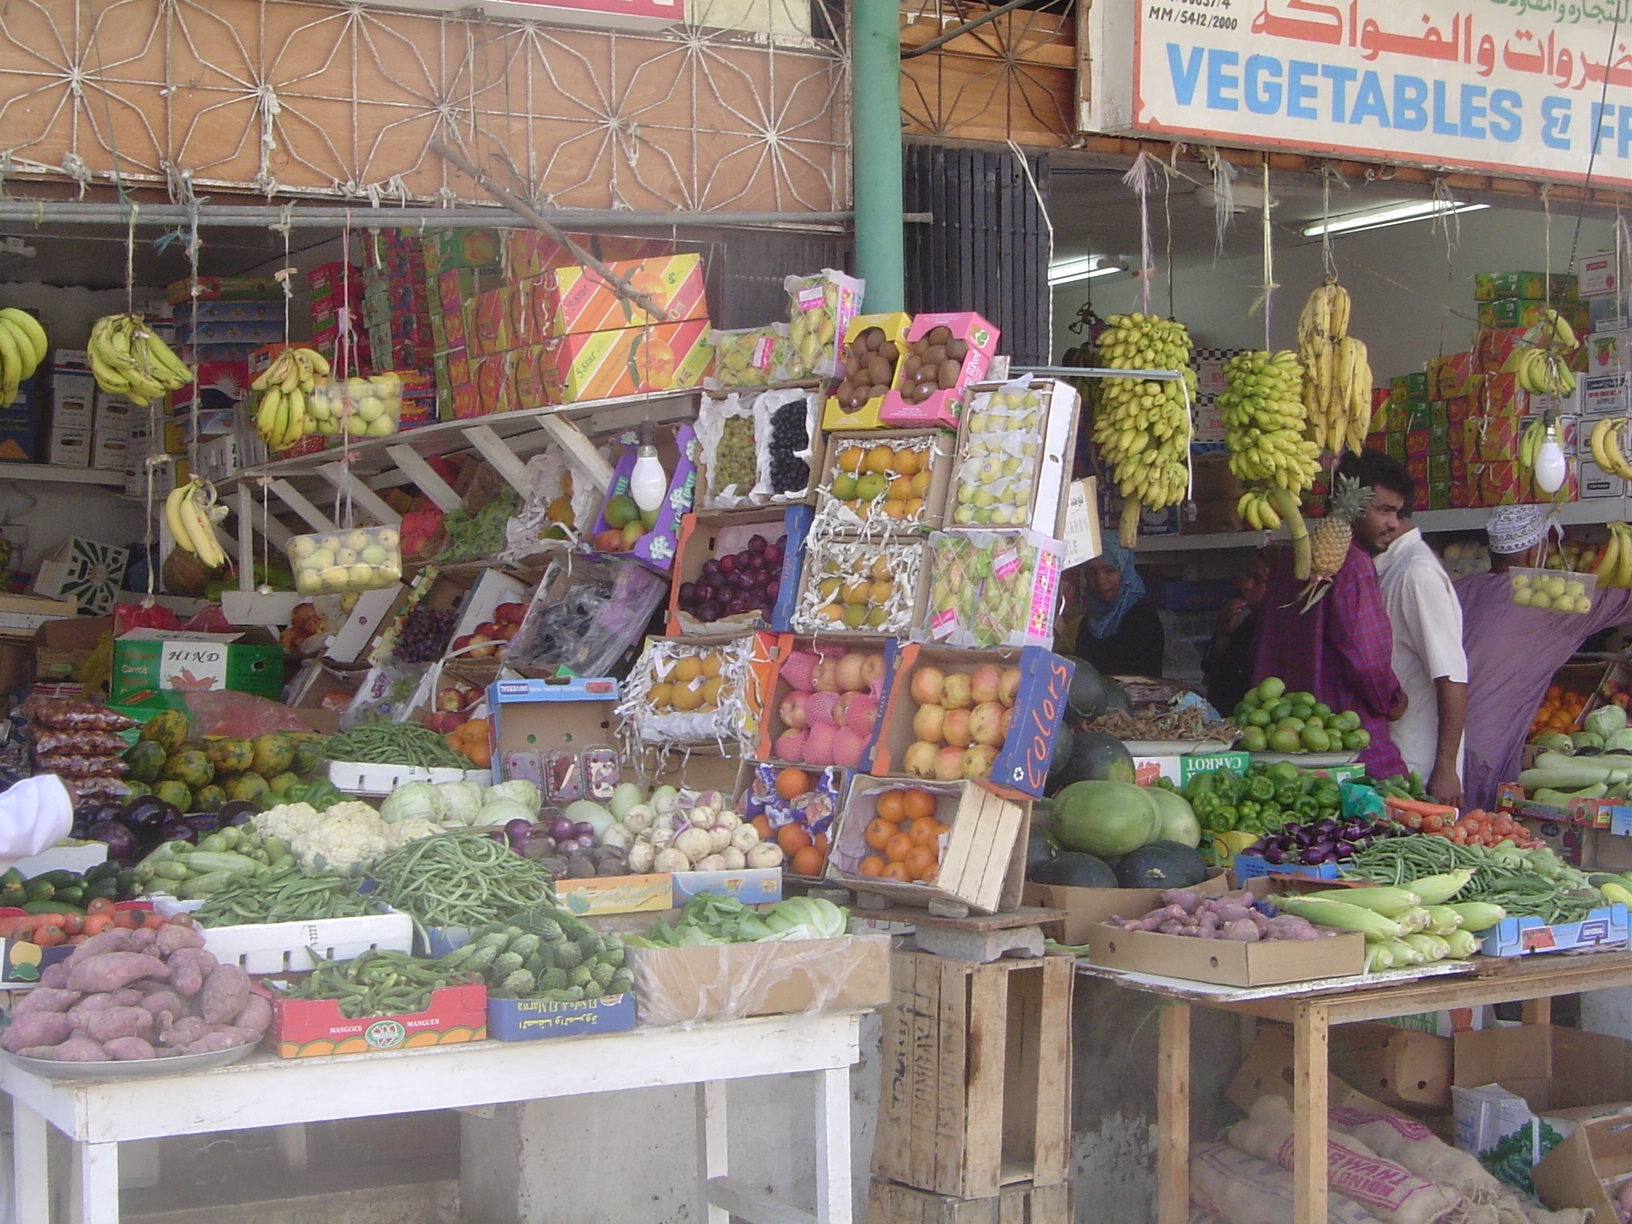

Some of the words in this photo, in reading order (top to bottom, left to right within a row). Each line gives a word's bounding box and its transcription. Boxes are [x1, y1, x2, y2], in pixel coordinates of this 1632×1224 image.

[1149, 6, 1238, 31] MM/5412/2000
[1166, 42, 1523, 143] VEGETABLES
[1541, 96, 1572, 151] &
[168, 650, 220, 664] HIND
[1186, 756, 1243, 769] CARROT
[517, 1002, 547, 1013] Marwa
